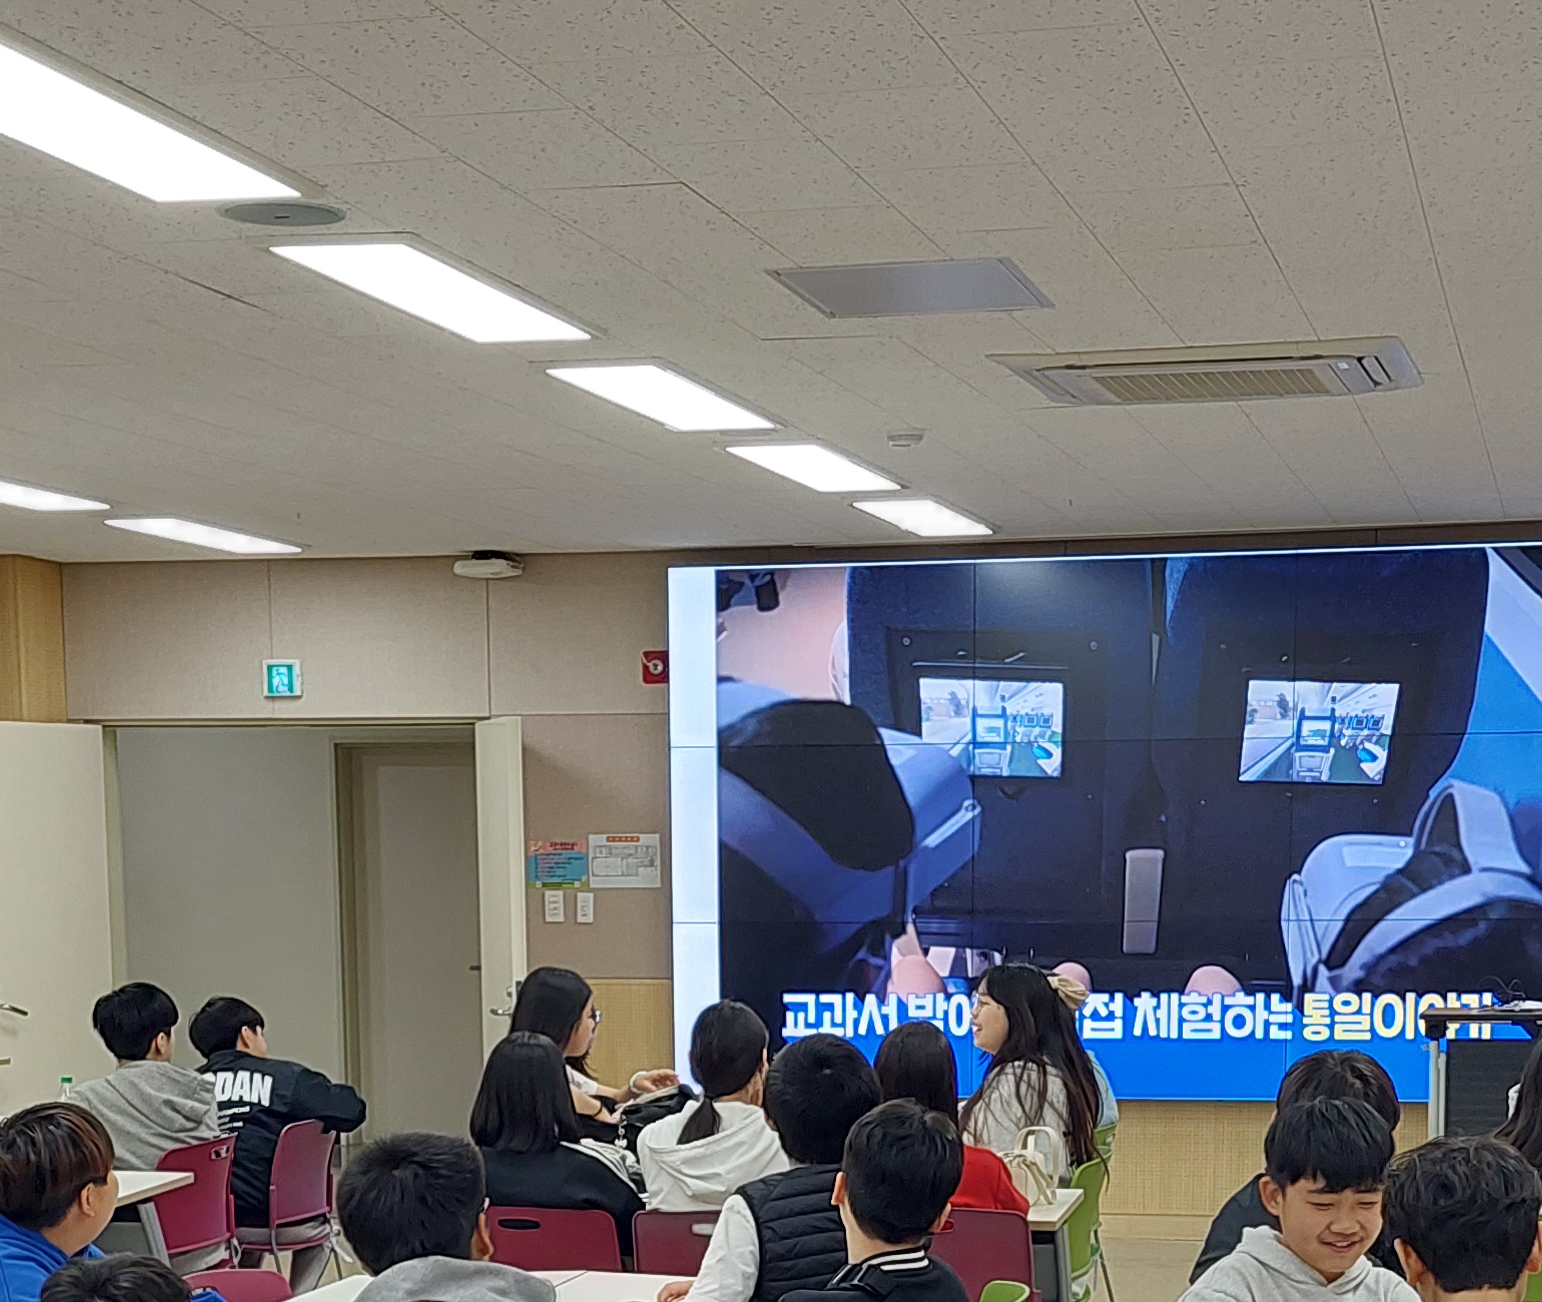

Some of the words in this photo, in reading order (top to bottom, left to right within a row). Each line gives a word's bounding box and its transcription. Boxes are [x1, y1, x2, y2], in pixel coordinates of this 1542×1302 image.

[781, 992, 898, 1038] 교과서
[1075, 992, 1124, 1039] 접
[1133, 992, 1293, 1040] 체험하는
[214, 1070, 274, 1107] DAN
